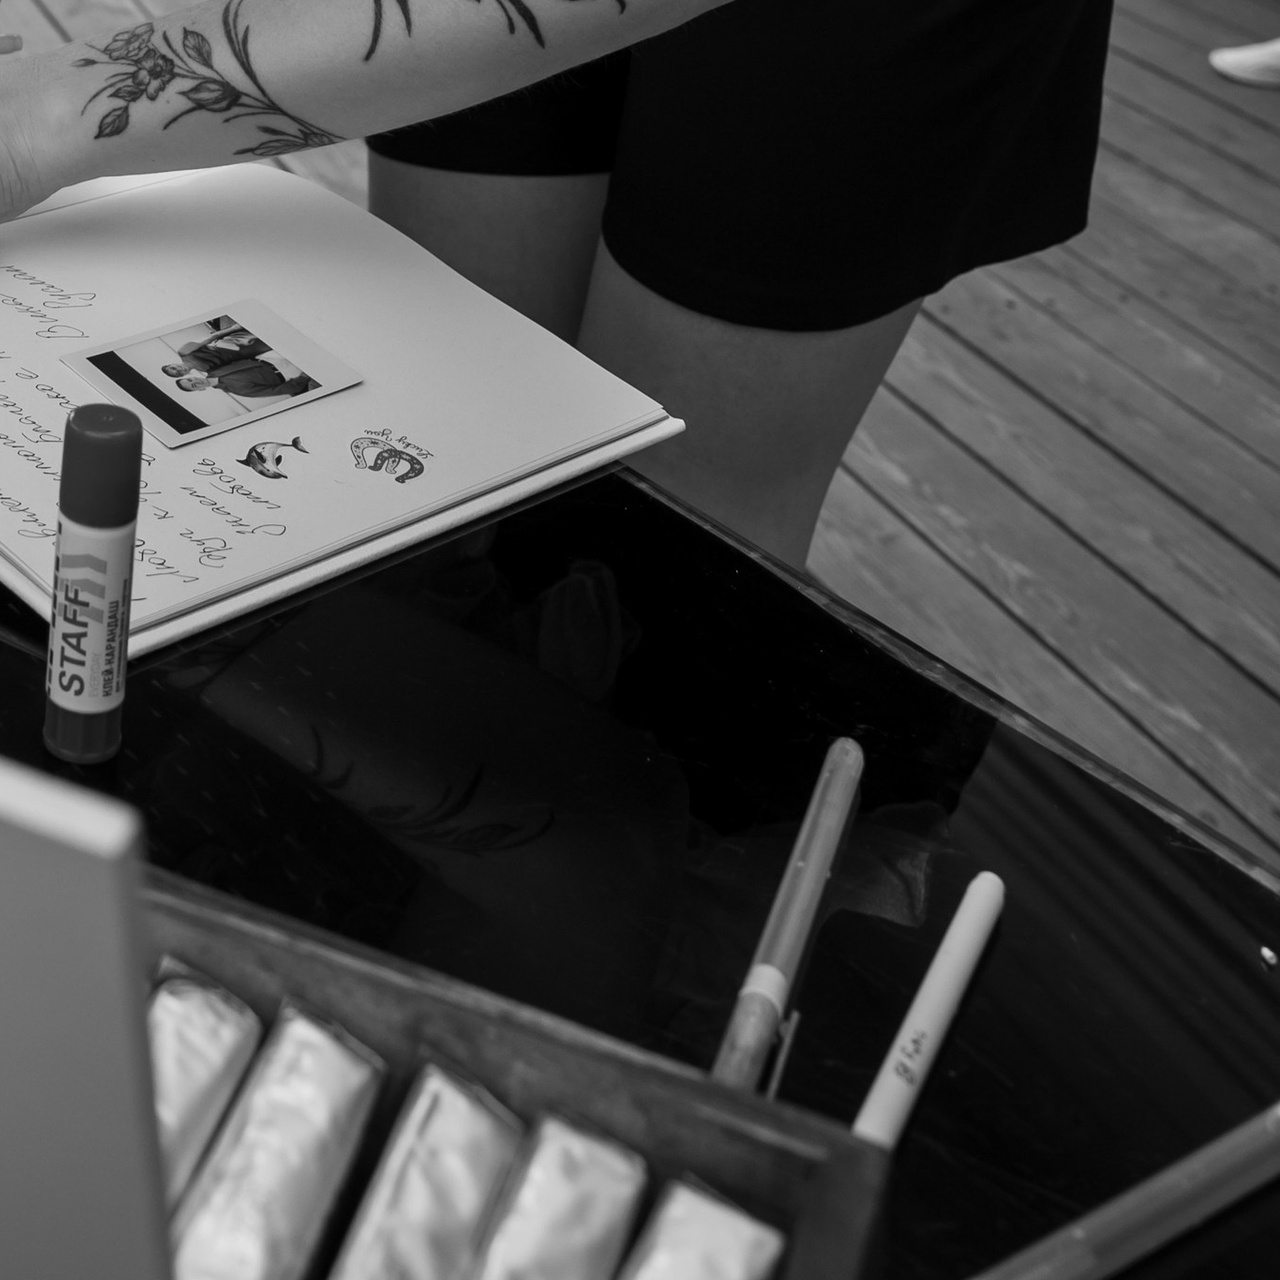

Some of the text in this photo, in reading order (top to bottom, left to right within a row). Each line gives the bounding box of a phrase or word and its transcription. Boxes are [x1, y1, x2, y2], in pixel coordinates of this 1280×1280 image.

[363, 428, 434, 460] Lucky You
[153, 506, 174, 520] к
[58, 582, 90, 697] STAFF
[101, 599, 120, 698] КЛЕЙ-КАРАНДАШ
